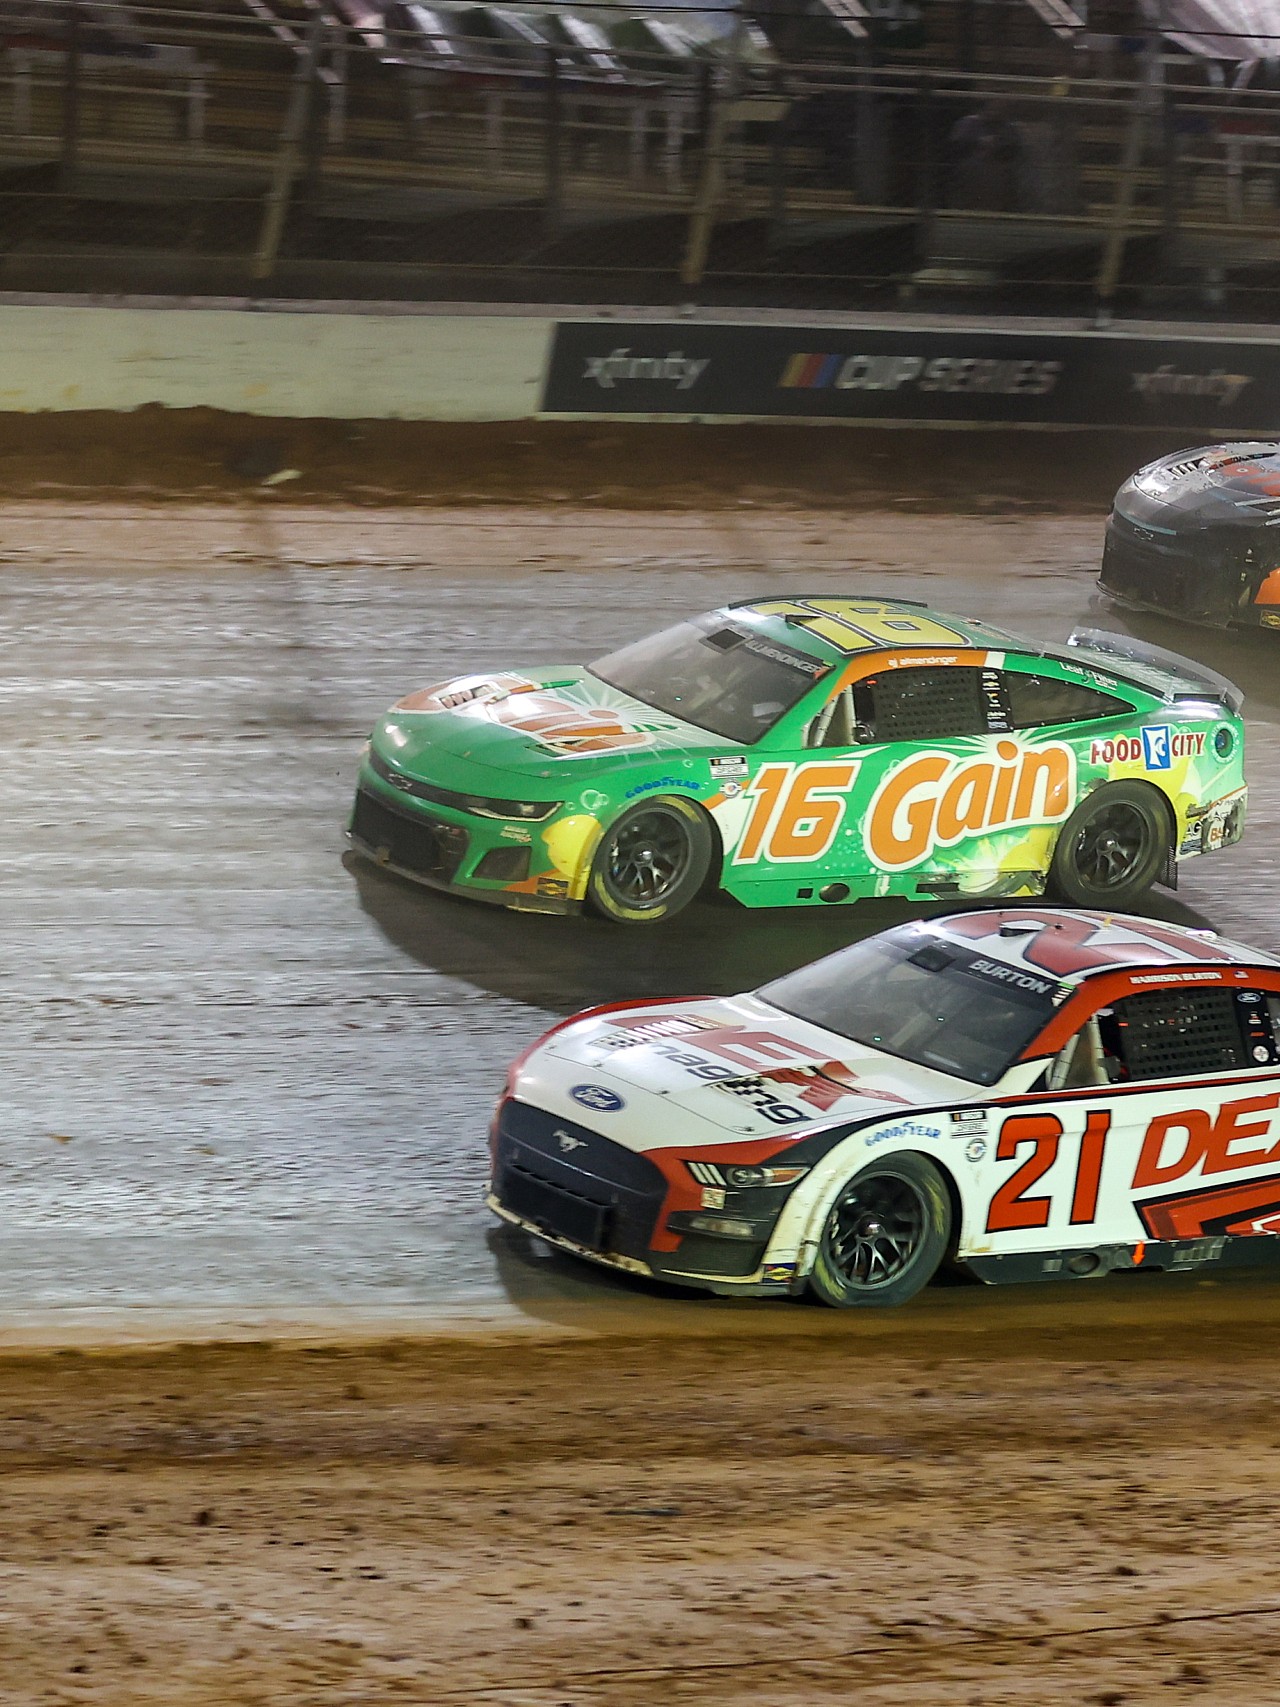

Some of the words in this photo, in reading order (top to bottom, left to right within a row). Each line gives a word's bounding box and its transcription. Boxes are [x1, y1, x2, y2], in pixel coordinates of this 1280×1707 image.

[834, 354, 922, 390] CUP
[920, 357, 1062, 395] SERIES
[1090, 739, 1142, 765] FOOD
[1170, 733, 1206, 757] CITY
[624, 777, 700, 798] GOODYEAR
[732, 760, 862, 866] 16
[863, 740, 1078, 872] Gain
[968, 959, 1052, 993] BURTON
[573, 1085, 622, 1110] Ford
[865, 1121, 941, 1146] GOODYEAR
[984, 1109, 1112, 1234] 21
